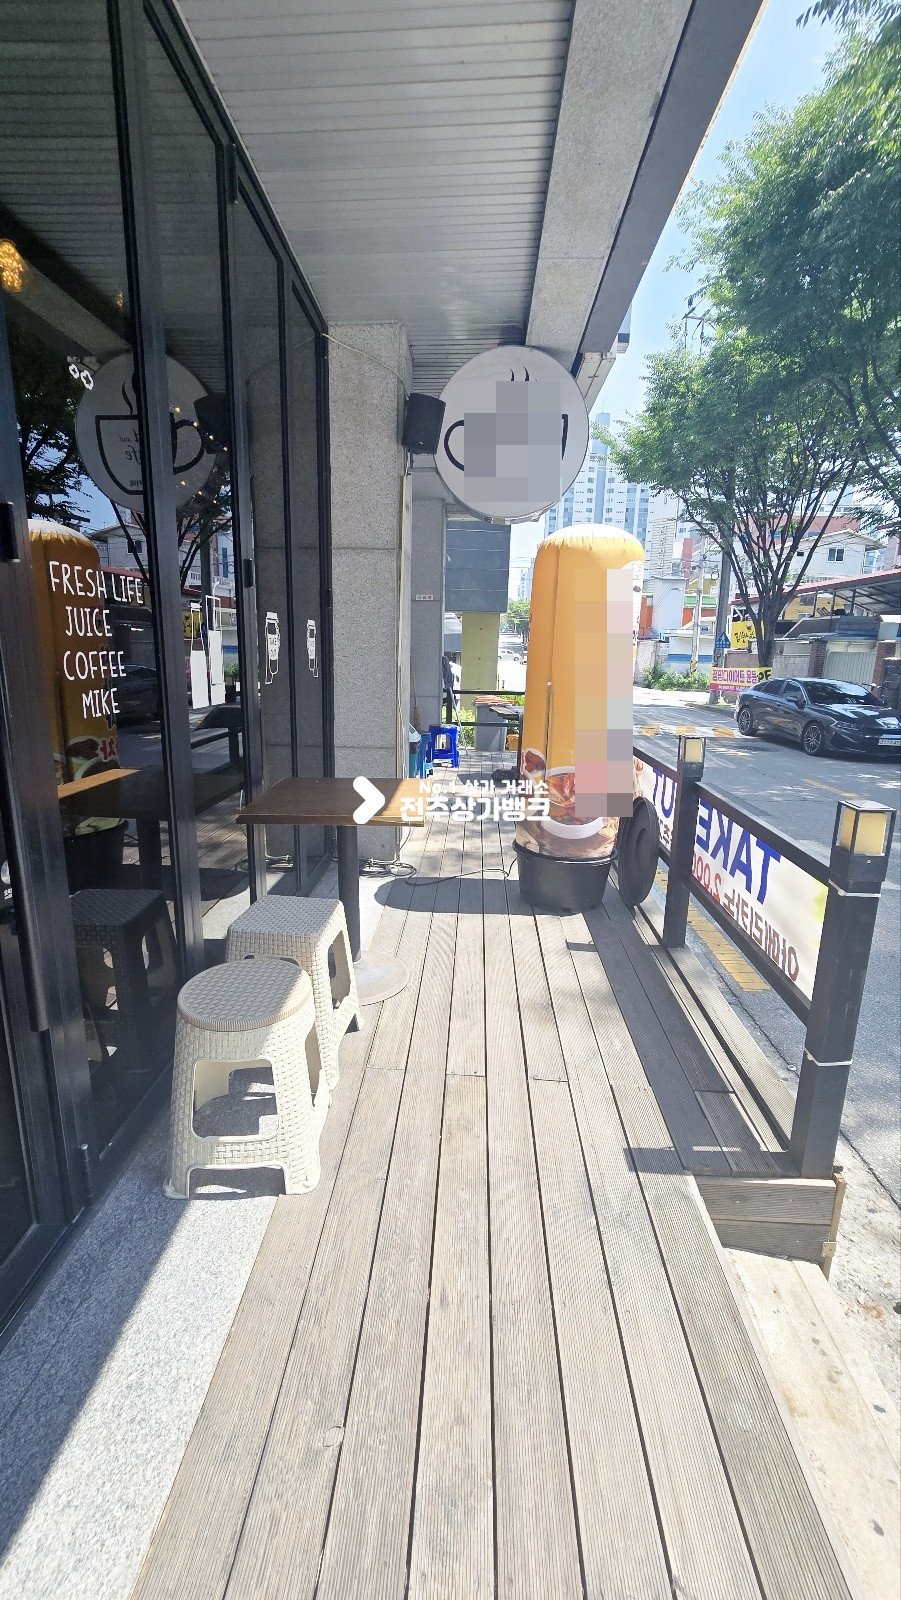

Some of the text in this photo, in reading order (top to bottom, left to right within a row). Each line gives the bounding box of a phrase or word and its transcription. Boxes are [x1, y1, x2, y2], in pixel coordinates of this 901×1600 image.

[49, 561, 144, 604] FRESH LIFE
[65, 605, 113, 637] JUICE
[63, 650, 127, 681] COFFEE
[82, 687, 121, 719] MIKE
